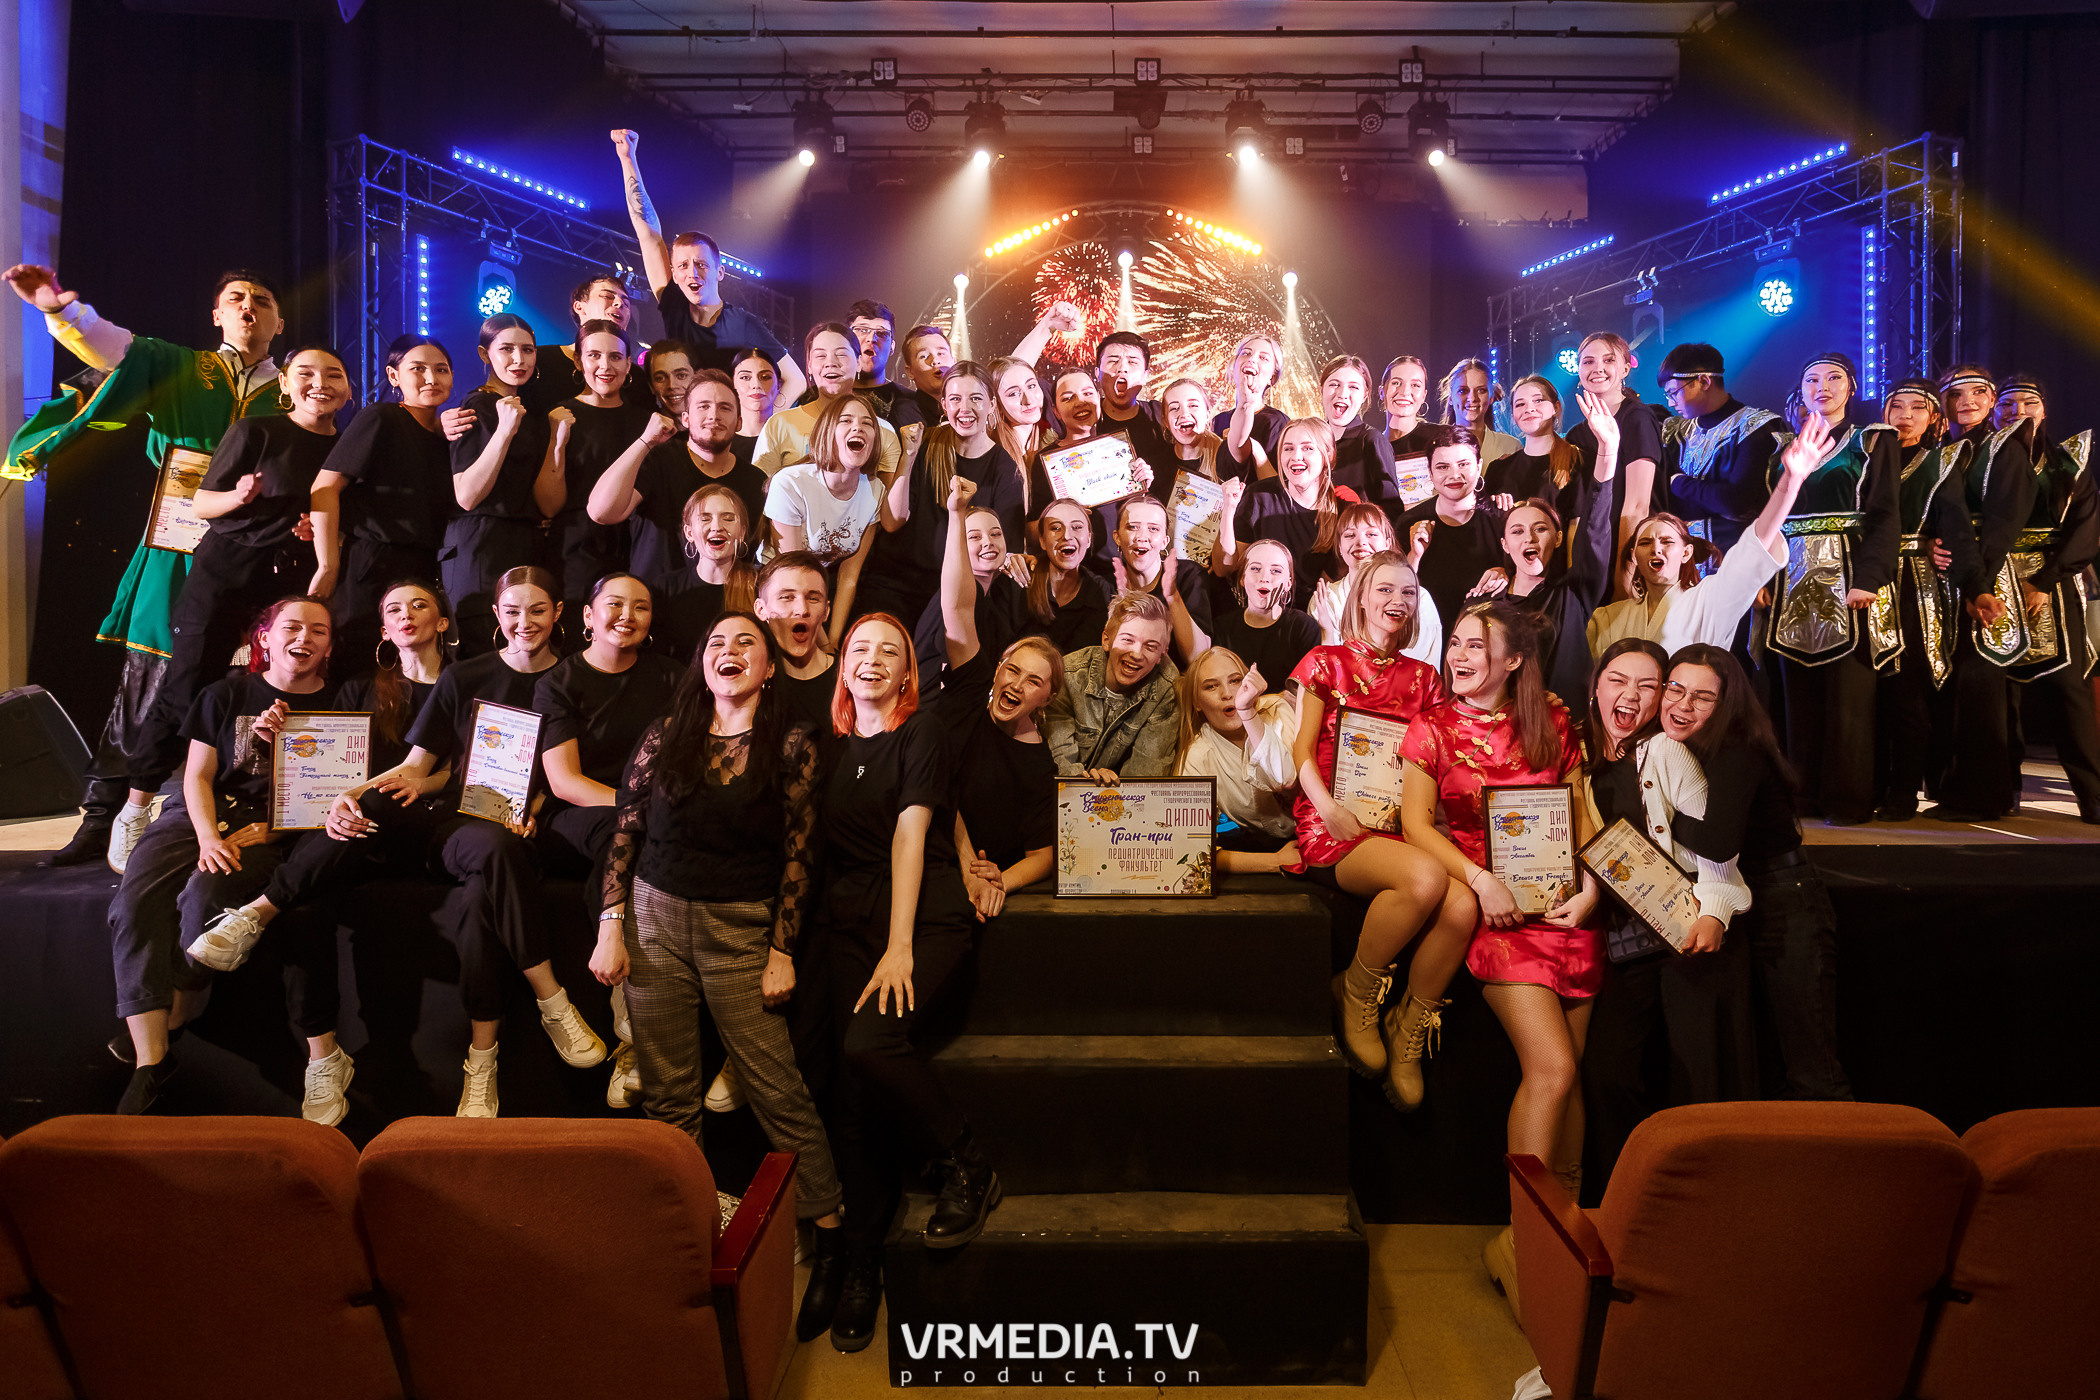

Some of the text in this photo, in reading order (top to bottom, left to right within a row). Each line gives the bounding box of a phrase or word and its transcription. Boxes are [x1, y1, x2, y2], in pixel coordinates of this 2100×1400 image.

[347, 735, 366, 749] ДИП
[345, 750, 365, 764] ЛОМ
[276, 783, 291, 807] МЕСТО
[1335, 776, 1347, 802] МЕСТО
[1080, 791, 1146, 804] Студенческая
[1082, 801, 1109, 813] Весна
[1549, 810, 1567, 826] ДИП
[1110, 827, 1173, 846] Гран-при
[1549, 827, 1568, 842] ЛОМ
[1108, 847, 1174, 860] ПЕДИАТРИЧЕСКИЙ
[1119, 860, 1163, 872] ФАКУЛЬТЕТ
